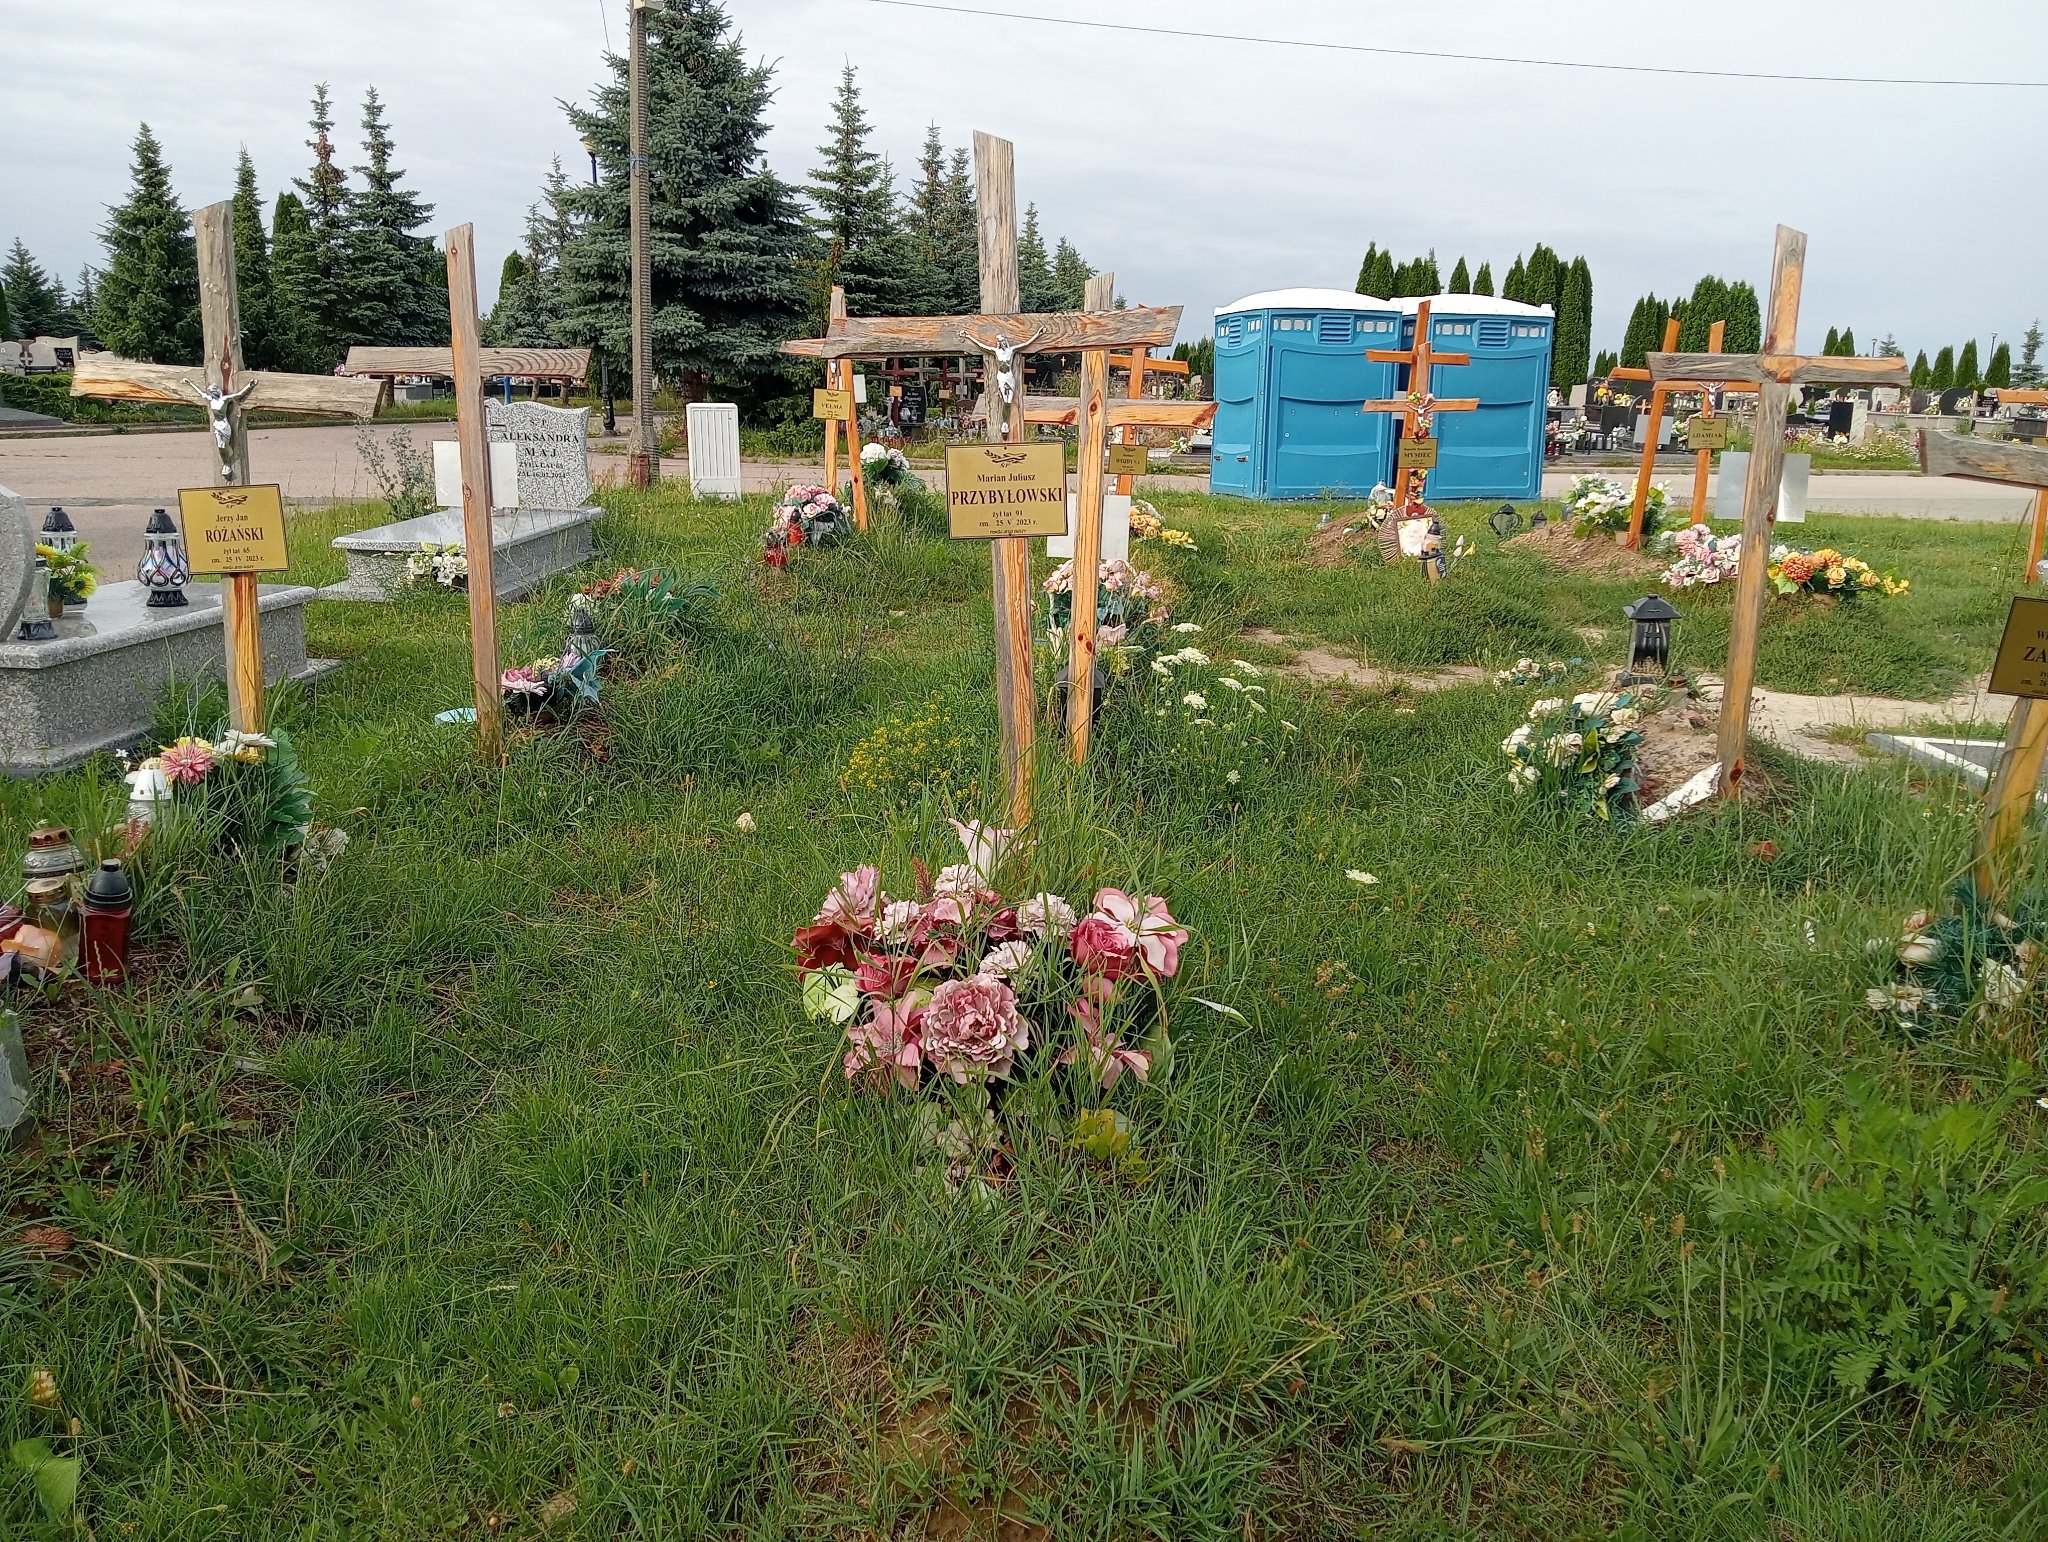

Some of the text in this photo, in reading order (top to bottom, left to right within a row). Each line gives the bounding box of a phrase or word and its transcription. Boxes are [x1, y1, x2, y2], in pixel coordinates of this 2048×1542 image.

[502, 432, 579, 443] ALEKSANDRA
[977, 473, 1036, 482] Marian Juliusz
[952, 487, 1063, 505] PRZYBYŁOWSKI
[216, 514, 248, 523] Jerzy Jan
[996, 519, 1004, 527] 25
[1016, 518, 1032, 526] 2023
[205, 525, 264, 543] RÓŻAŃSKI
